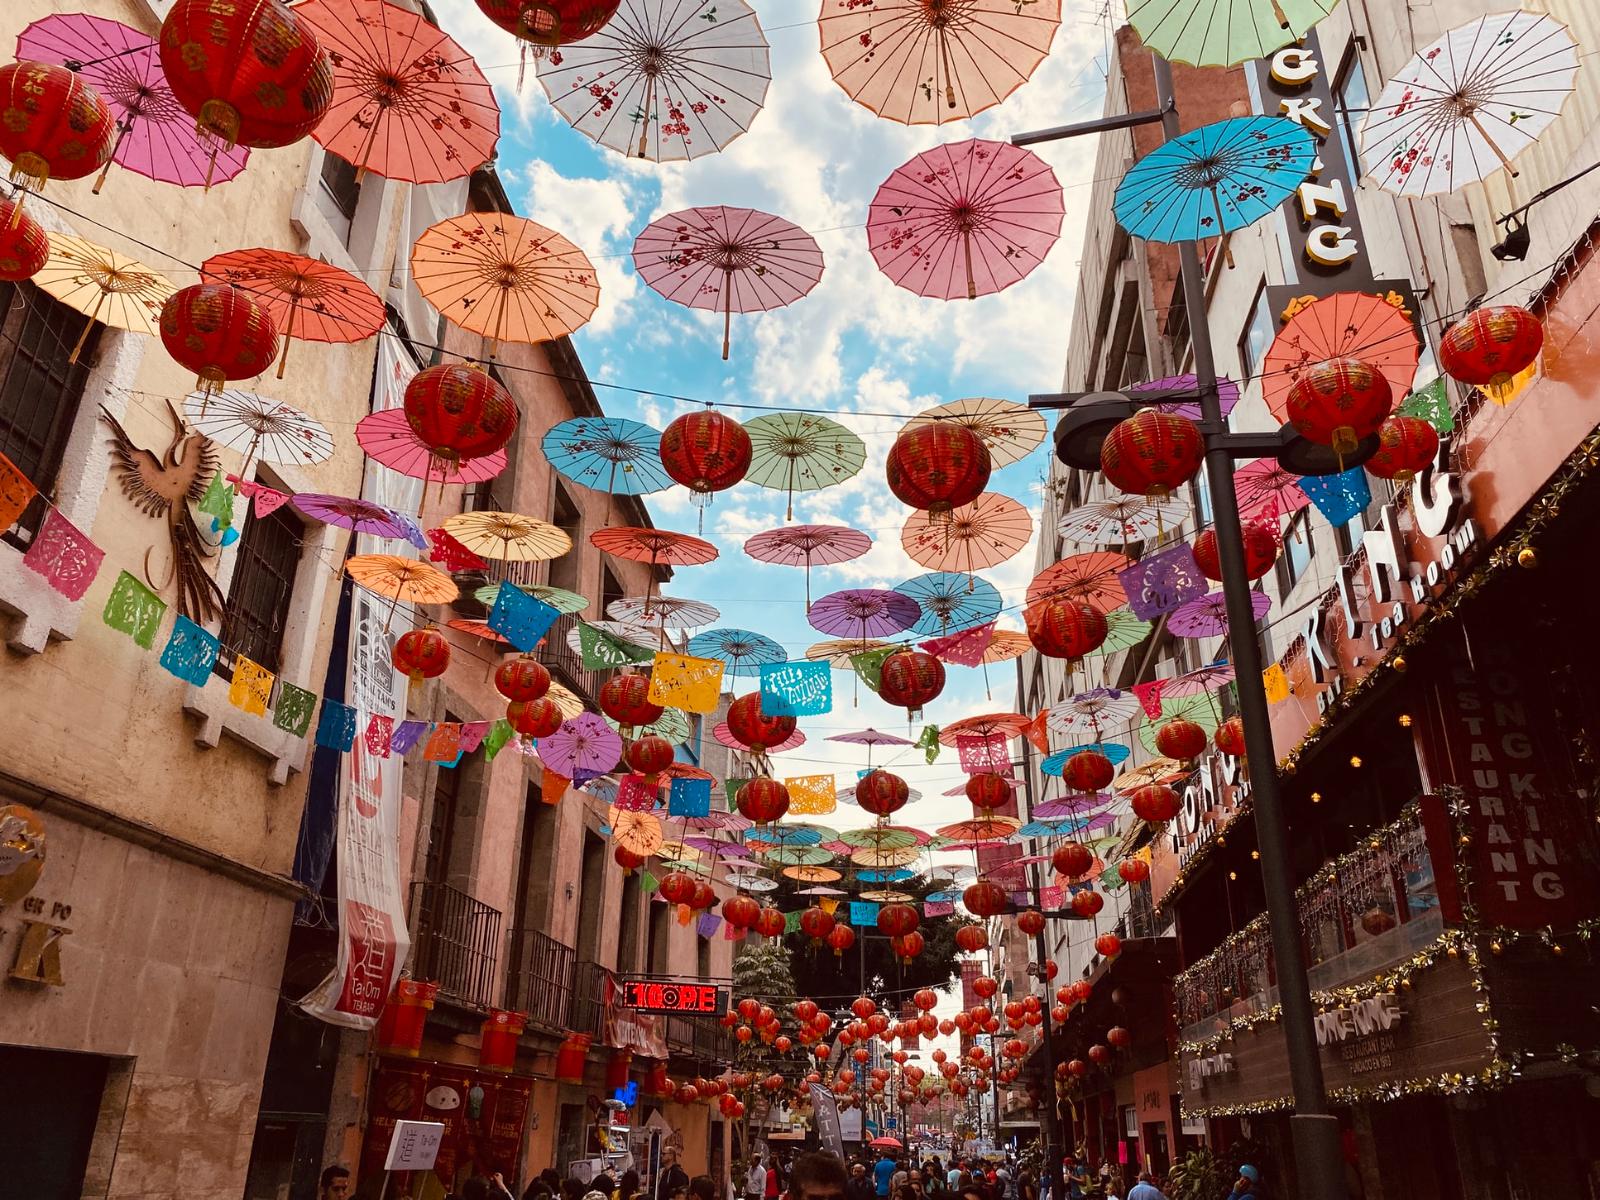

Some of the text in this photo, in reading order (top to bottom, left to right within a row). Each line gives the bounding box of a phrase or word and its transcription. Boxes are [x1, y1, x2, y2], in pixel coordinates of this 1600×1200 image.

[1280, 97, 1358, 266] KNG
[1370, 602, 1404, 651] Tea
[1411, 519, 1477, 604] Room
[1508, 772, 1565, 900] KING
